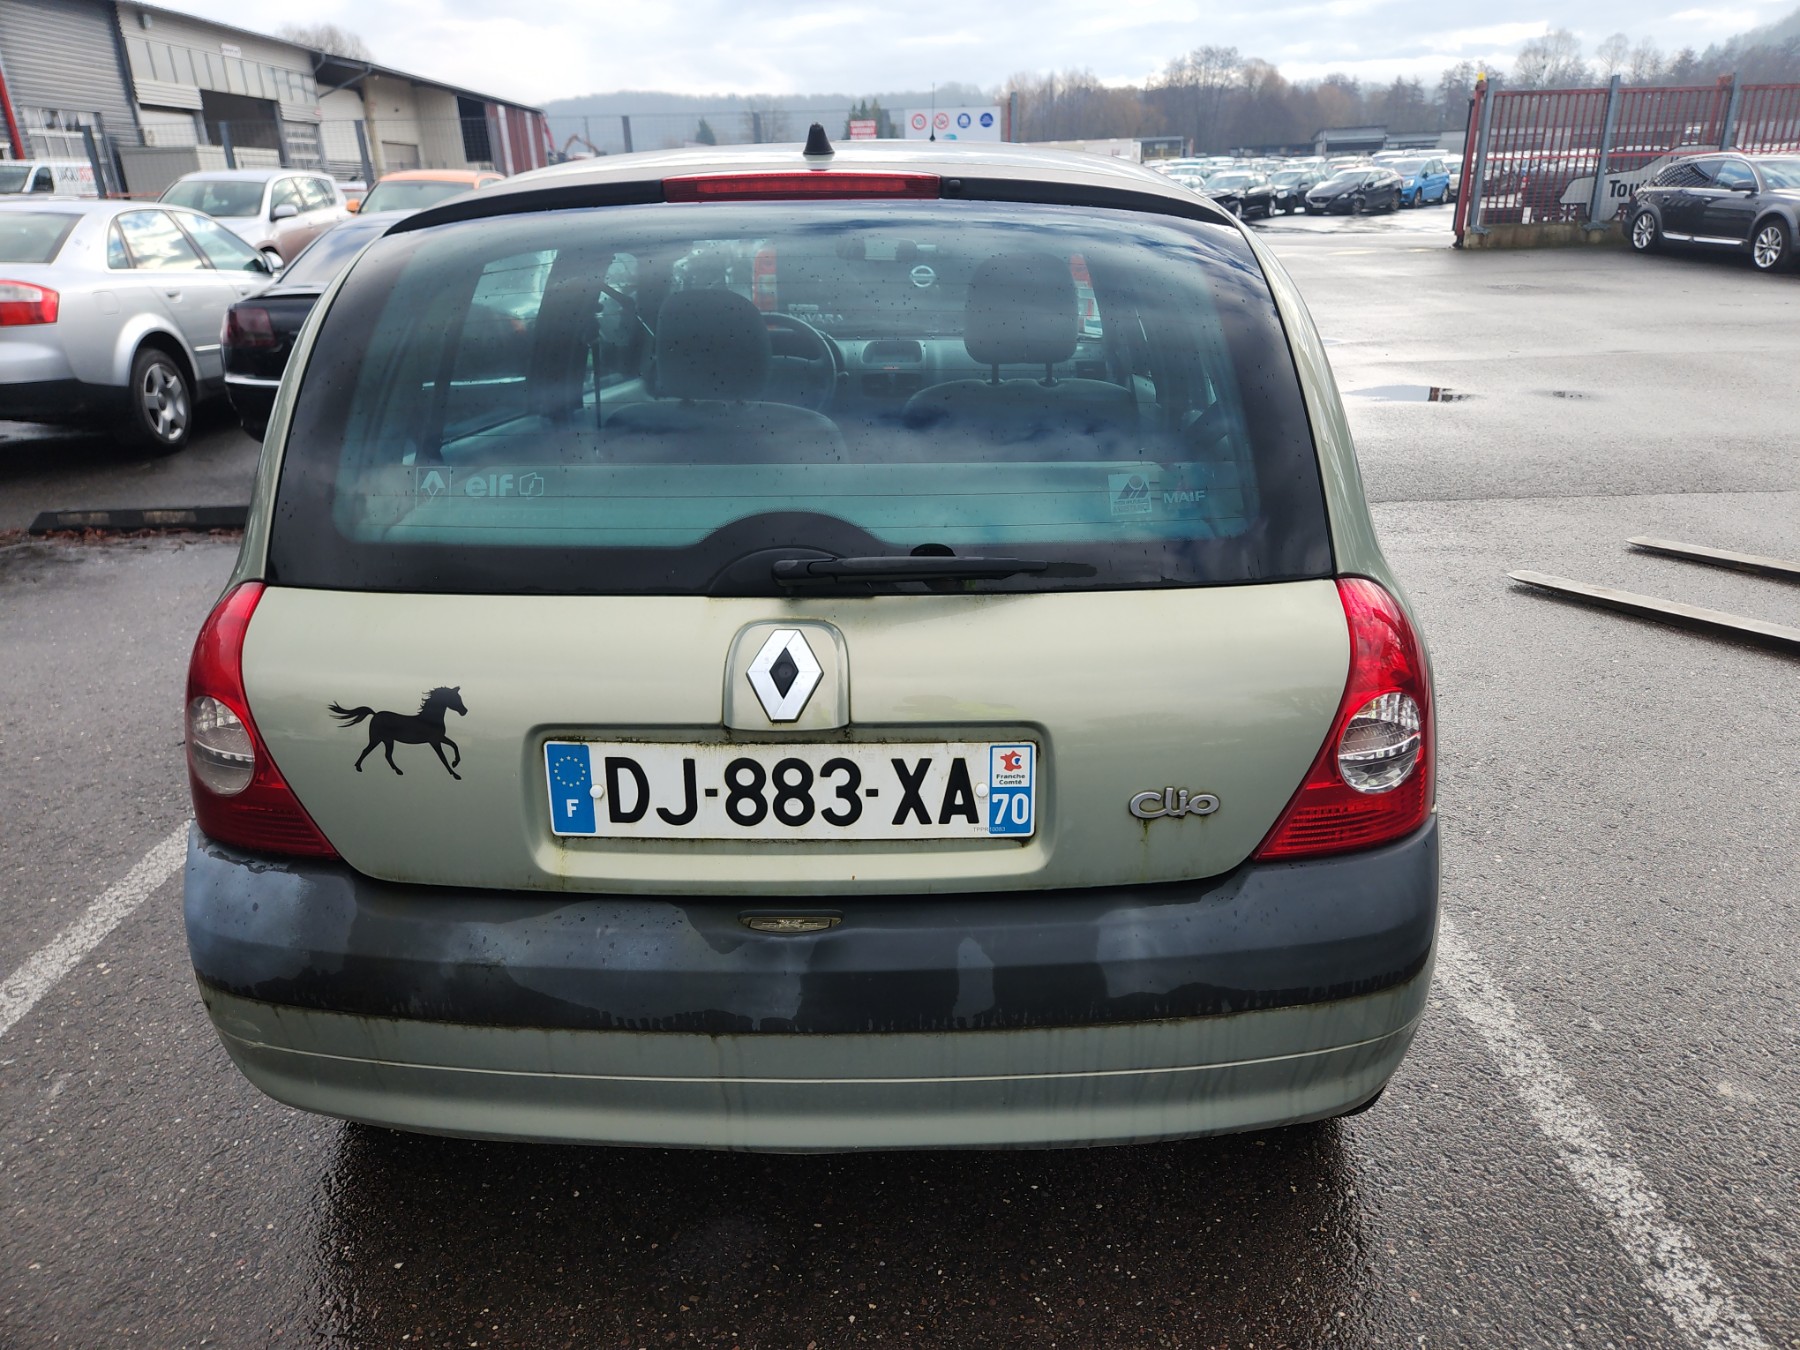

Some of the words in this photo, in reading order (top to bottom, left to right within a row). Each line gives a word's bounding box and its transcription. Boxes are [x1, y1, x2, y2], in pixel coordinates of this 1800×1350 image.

[465, 473, 514, 498] elf
[1163, 490, 1206, 504] MAIF
[605, 756, 980, 827] DJ-883-XA
[1129, 786, 1220, 819] Clio
[566, 799, 579, 818] F
[991, 792, 1030, 825] 70
